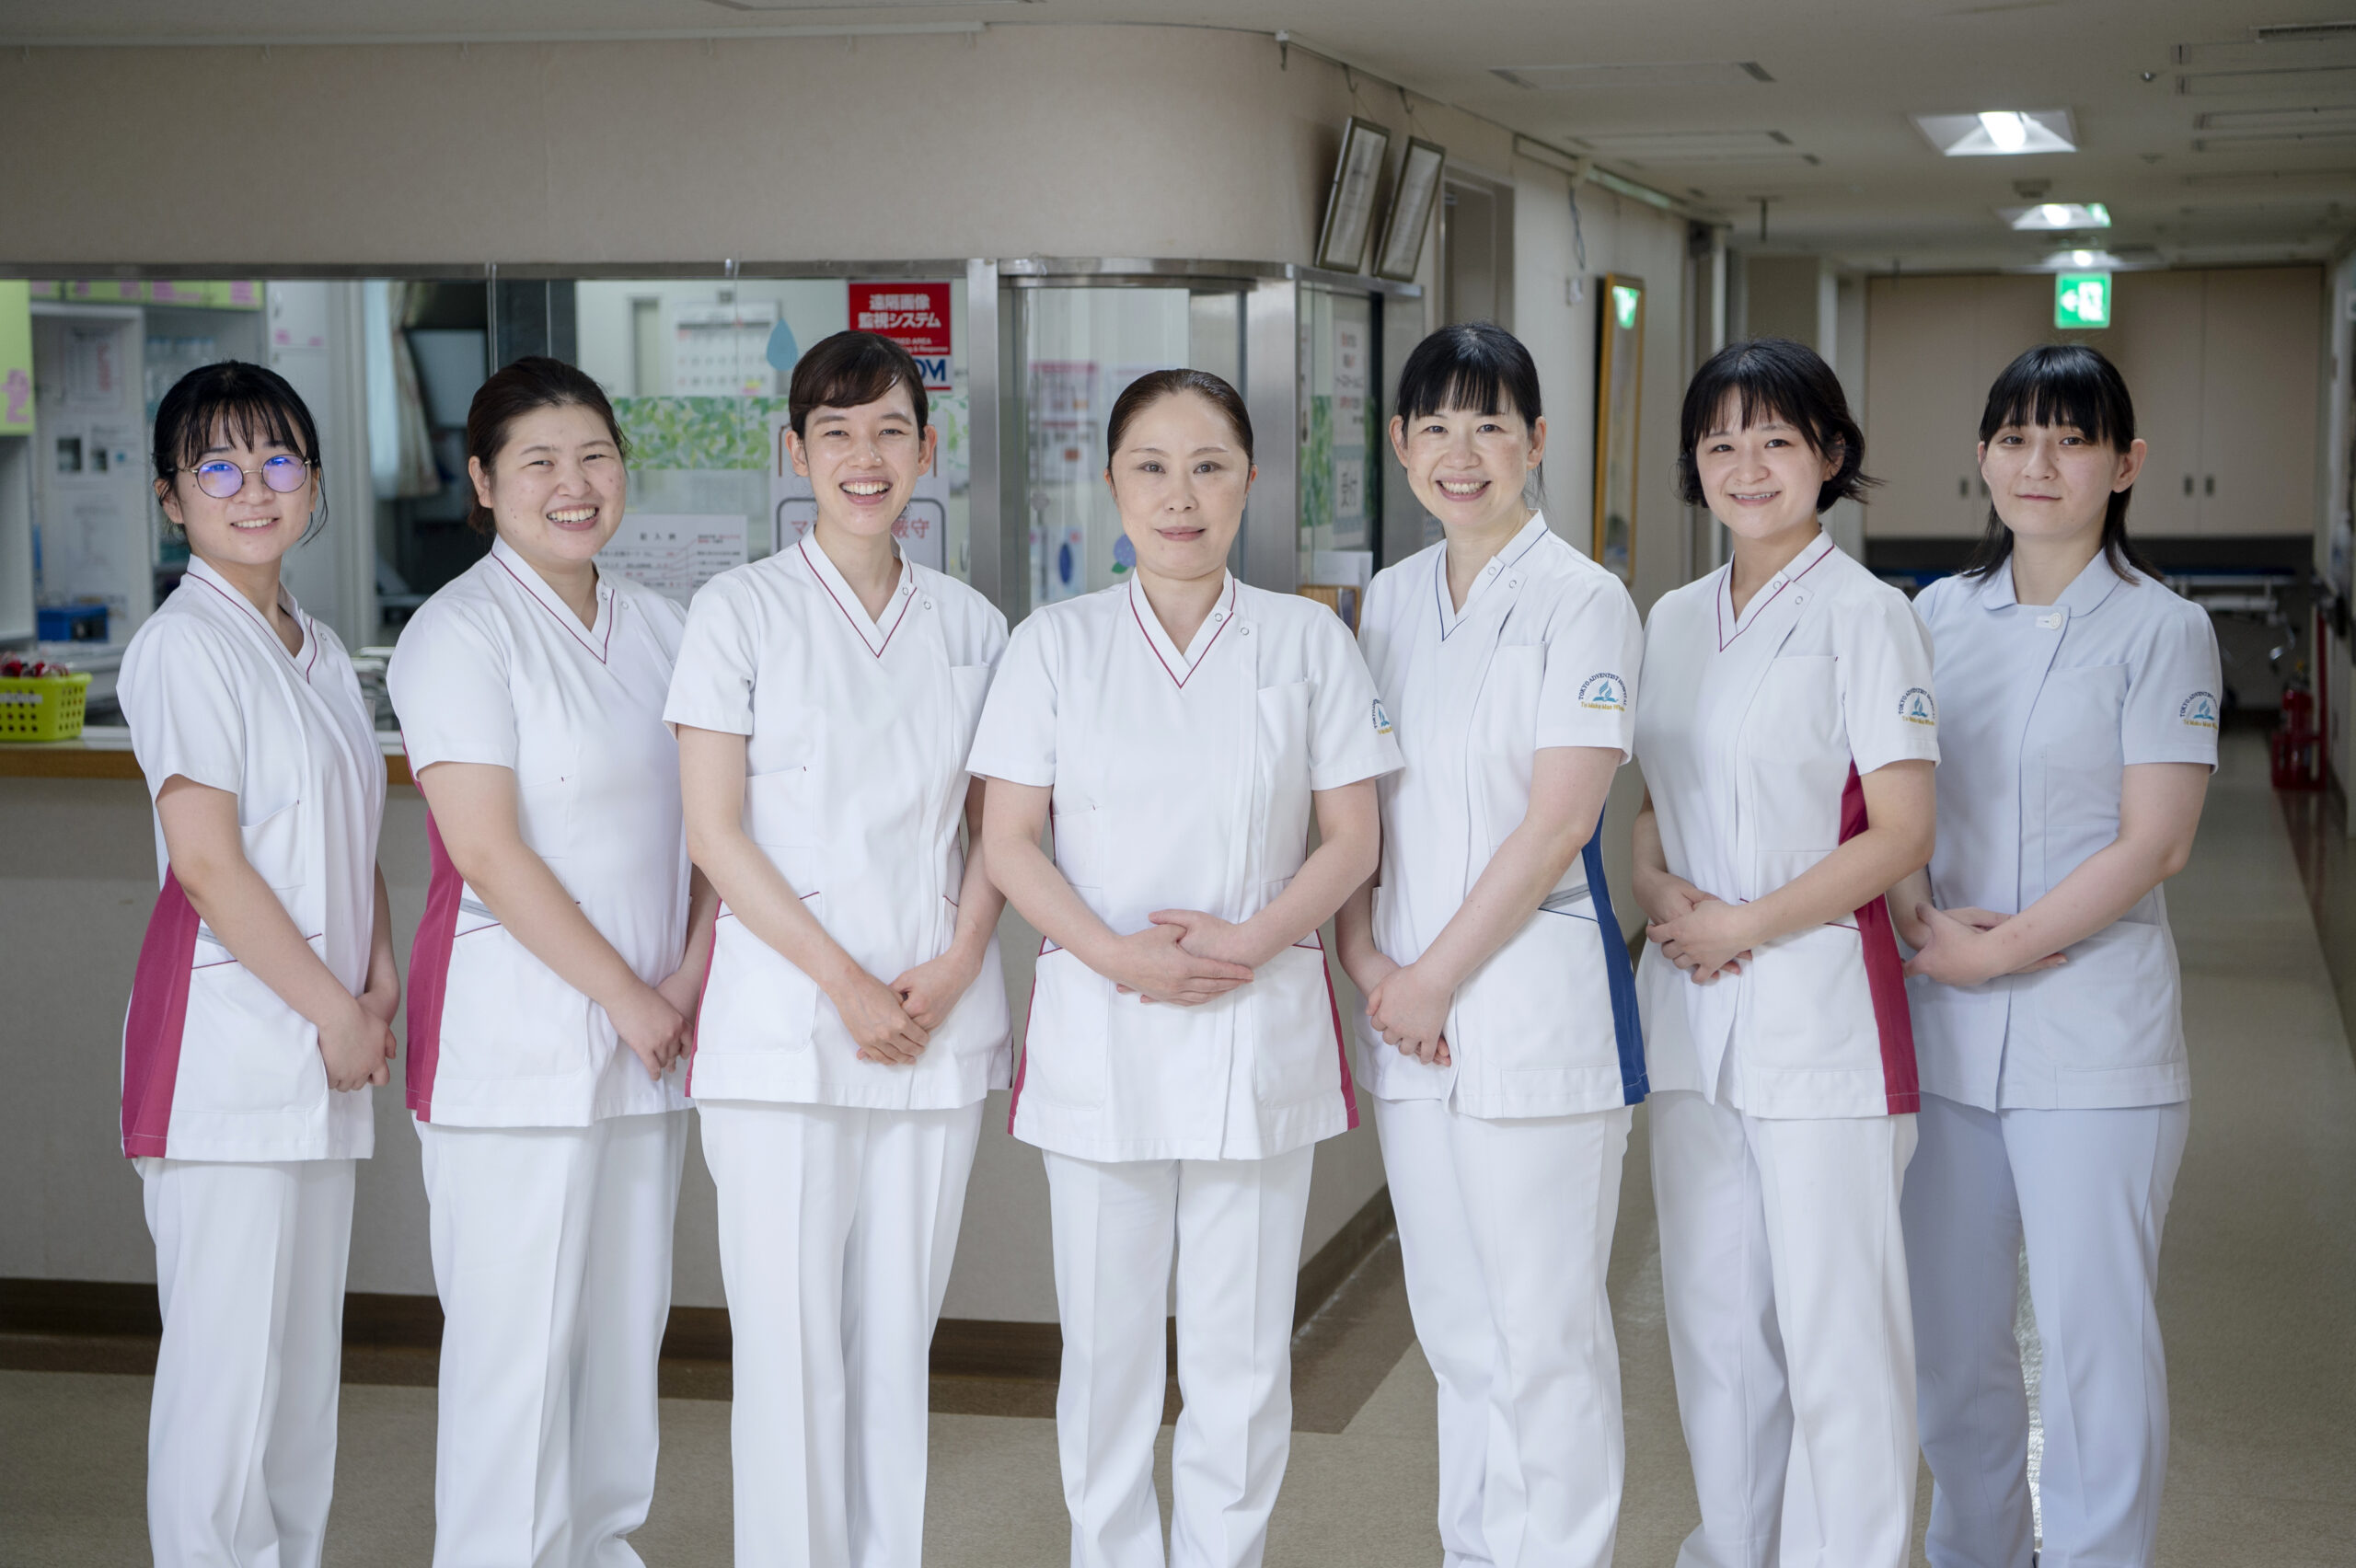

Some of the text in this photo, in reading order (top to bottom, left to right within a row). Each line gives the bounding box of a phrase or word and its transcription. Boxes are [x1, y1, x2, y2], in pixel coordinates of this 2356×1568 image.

[869, 294, 930, 311] 遠隔画像
[858, 312, 942, 329] 監視システム
[912, 337, 932, 345] AREA
[1578, 680, 1590, 700] TOKYO
[1589, 673, 1620, 683] ADVENTIST
[2179, 698, 2190, 718] TOKYO
